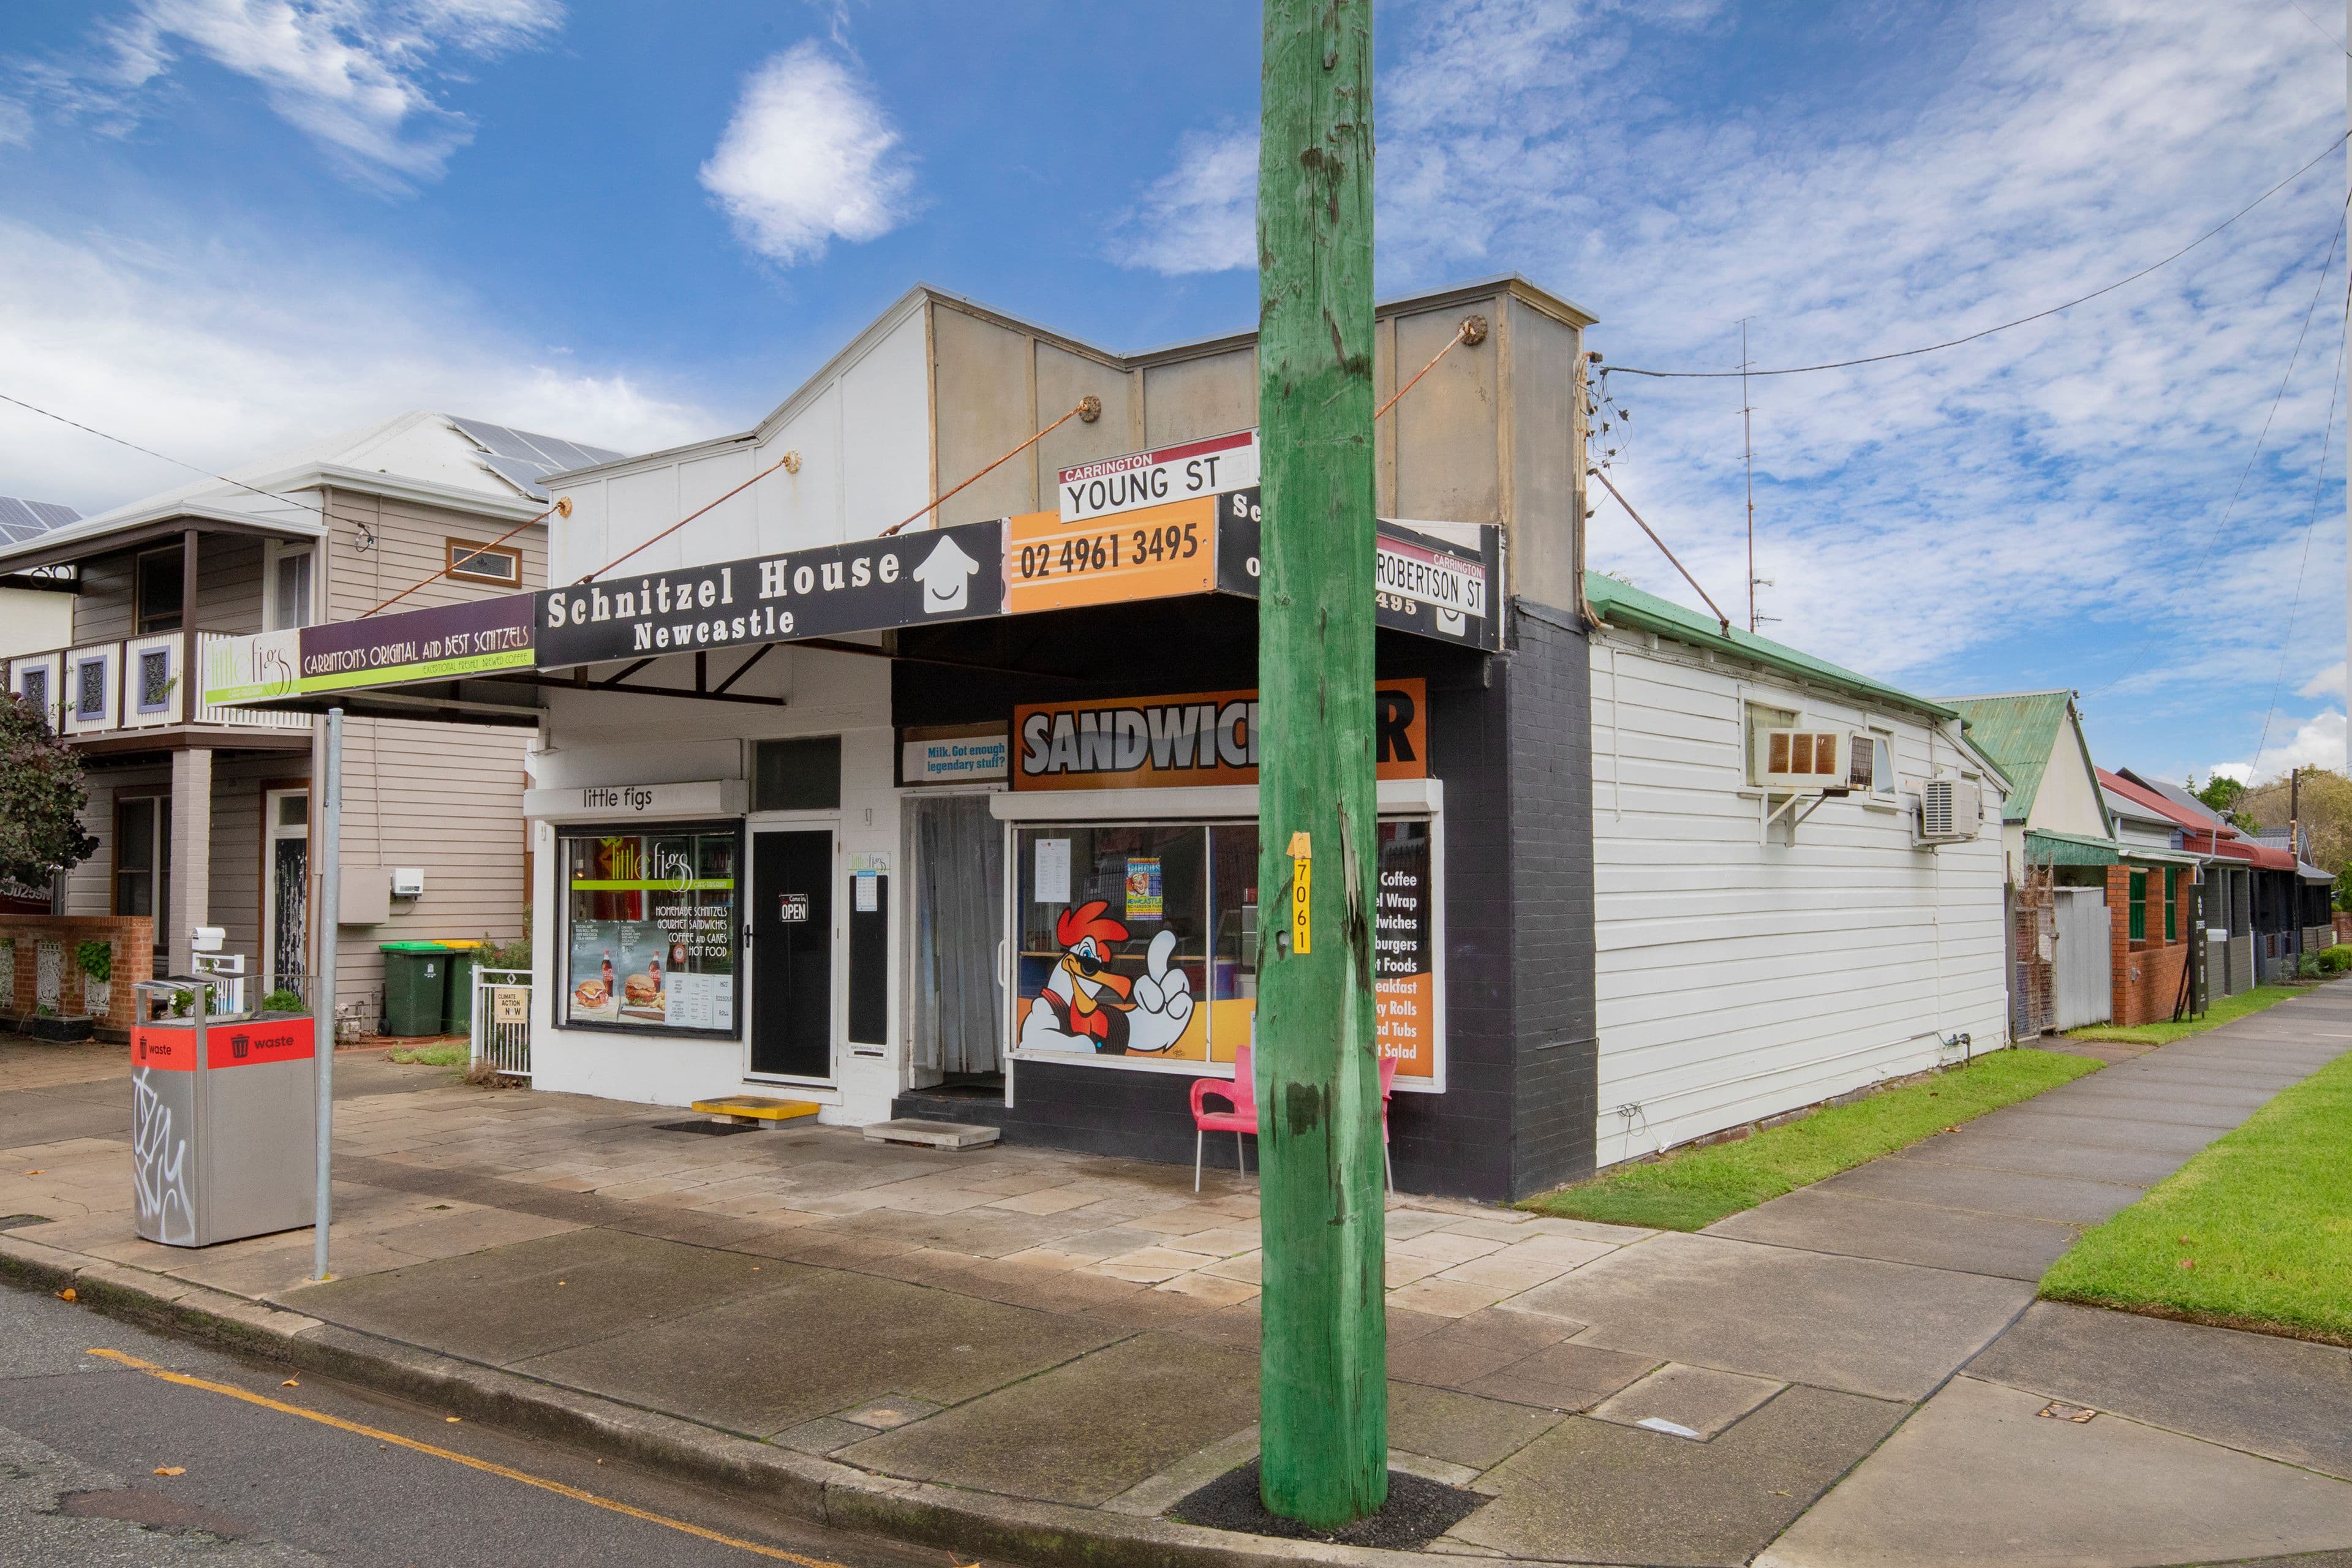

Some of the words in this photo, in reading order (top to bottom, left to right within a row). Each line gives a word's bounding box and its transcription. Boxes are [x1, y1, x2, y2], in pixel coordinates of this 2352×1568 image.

[1065, 453, 1152, 482] CARRINGTON
[1067, 467, 1168, 513] YOUNG
[1186, 456, 1221, 491] ST
[1021, 543, 1050, 579] 02
[1060, 533, 1119, 574] 4961
[1132, 522, 1198, 565] 3495
[1434, 554, 1482, 578] CARRINGTON
[1378, 552, 1458, 603] ROBERTSON
[1467, 579, 1482, 609] ST
[548, 567, 733, 628] Schnitzel
[759, 552, 900, 600] House
[633, 606, 794, 650] Newcastle
[370, 641, 419, 666] ORIGINAL
[423, 641, 442, 659] AND
[445, 633, 470, 657] BEST
[252, 636, 292, 698] figs
[423, 662, 456, 674] EXCEPTIONAL
[483, 655, 503, 668] BREWED
[505, 652, 528, 665] COFFEE
[928, 746, 951, 758] Milk.
[952, 745, 967, 756] Got
[970, 742, 1005, 756] enough
[927, 760, 974, 774] legendary
[977, 756, 1005, 769] stuff?
[584, 788, 618, 808] little
[624, 787, 652, 810] figs
[612, 843, 650, 880] little
[654, 842, 693, 892] figs
[1381, 871, 1417, 886] Coffee
[782, 903, 805, 919] OPEN
[1386, 893, 1417, 911] Wrap
[655, 907, 692, 916] HOMEMADE
[694, 907, 728, 917] SCHNITZELS
[657, 919, 687, 929] GOURMET
[689, 919, 728, 930] SANDWICHES
[668, 933, 694, 943] COFFEE
[707, 933, 727, 943] CAKES
[688, 946, 703, 956] HOT
[705, 946, 727, 957] FOOD
[1384, 957, 1417, 973] Foods
[1390, 1000, 1417, 1016] Rolls
[1392, 1022, 1417, 1038] Tubs
[149, 1044, 172, 1055] waste
[254, 1036, 294, 1049] waste
[1385, 1043, 1417, 1059] Salad
